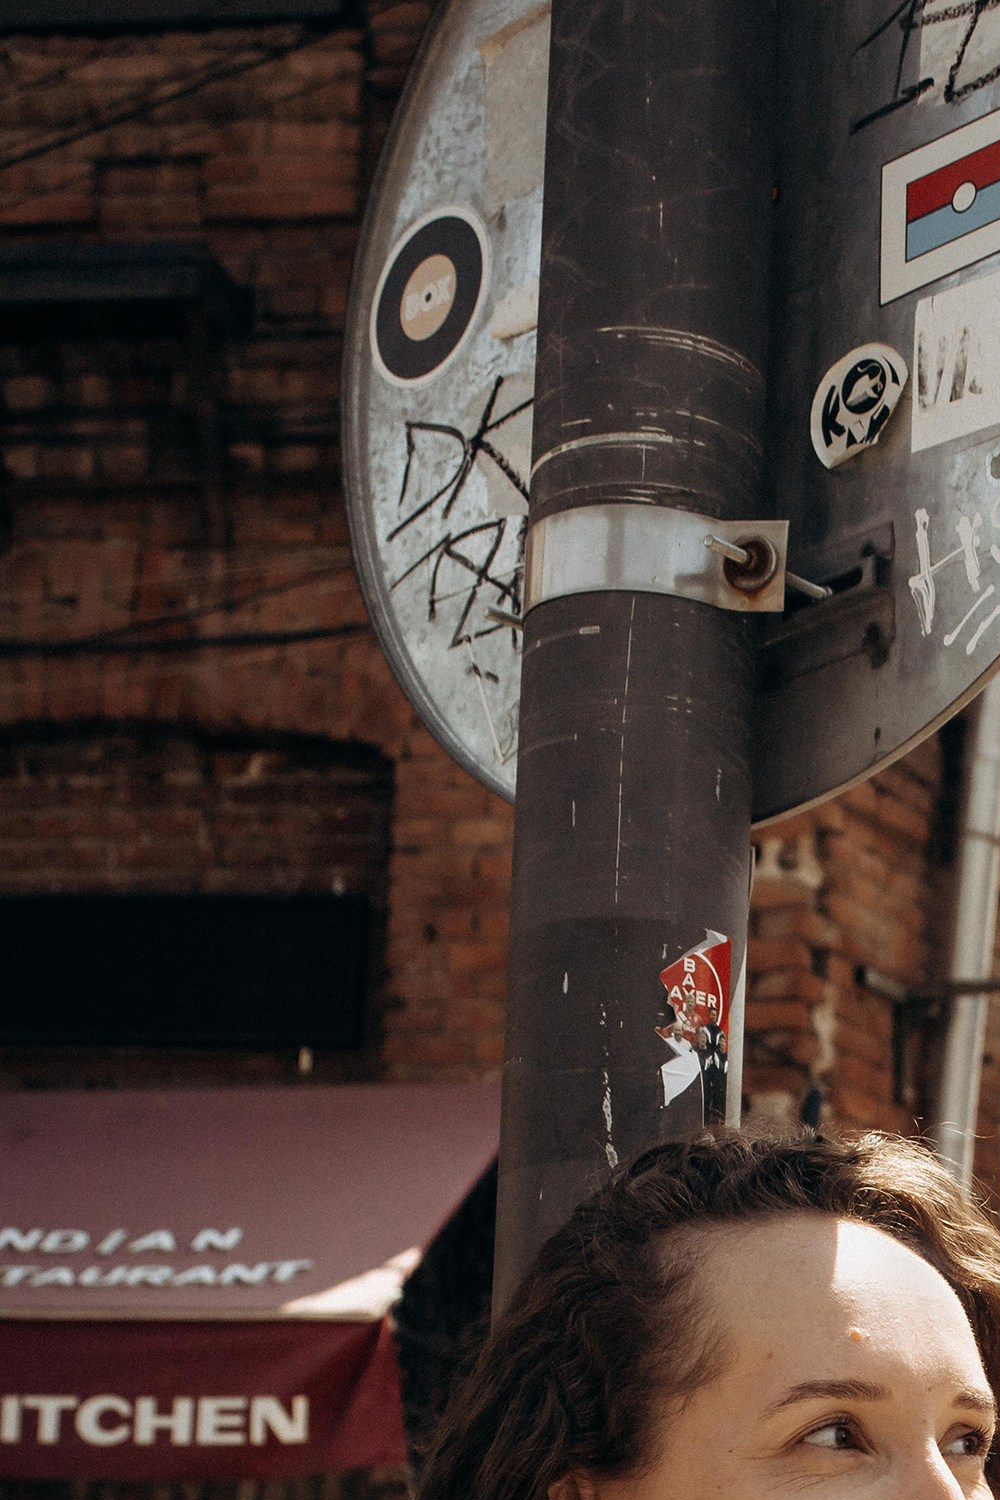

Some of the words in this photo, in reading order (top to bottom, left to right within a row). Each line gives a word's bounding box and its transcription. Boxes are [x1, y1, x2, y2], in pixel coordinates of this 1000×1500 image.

[0, 1227, 244, 1254] NDIAN
[0, 1259, 315, 1287] TAURANT
[0, 1395, 310, 1446] ITCHEN
